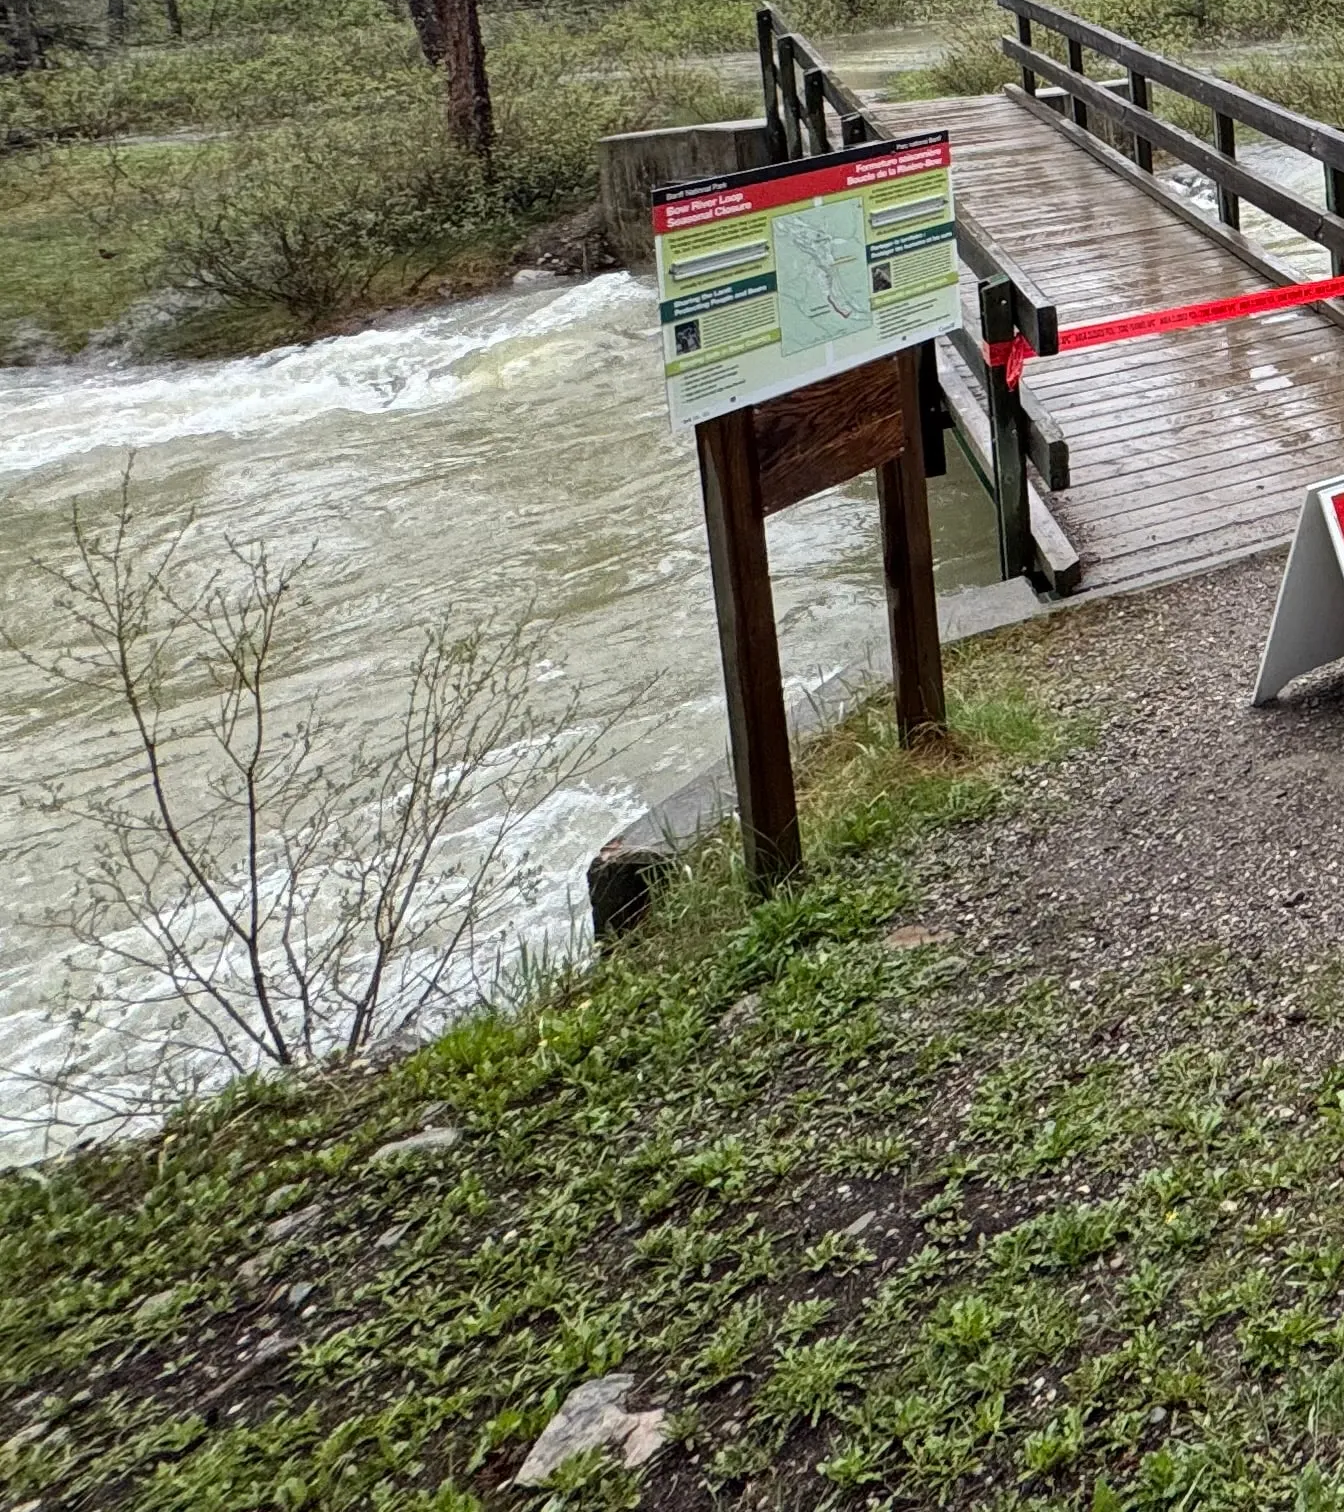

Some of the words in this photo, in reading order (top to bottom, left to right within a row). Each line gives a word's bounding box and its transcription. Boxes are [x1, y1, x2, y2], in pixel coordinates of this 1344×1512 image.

[856, 158, 897, 173] Fermeture
[666, 190, 684, 200] Banff
[686, 185, 712, 196] National
[712, 181, 727, 191] Park
[666, 204, 690, 217] Bow
[691, 198, 717, 211] River
[719, 192, 744, 205] Loop
[666, 210, 712, 228] Seasonal
[715, 202, 752, 217] Closure
